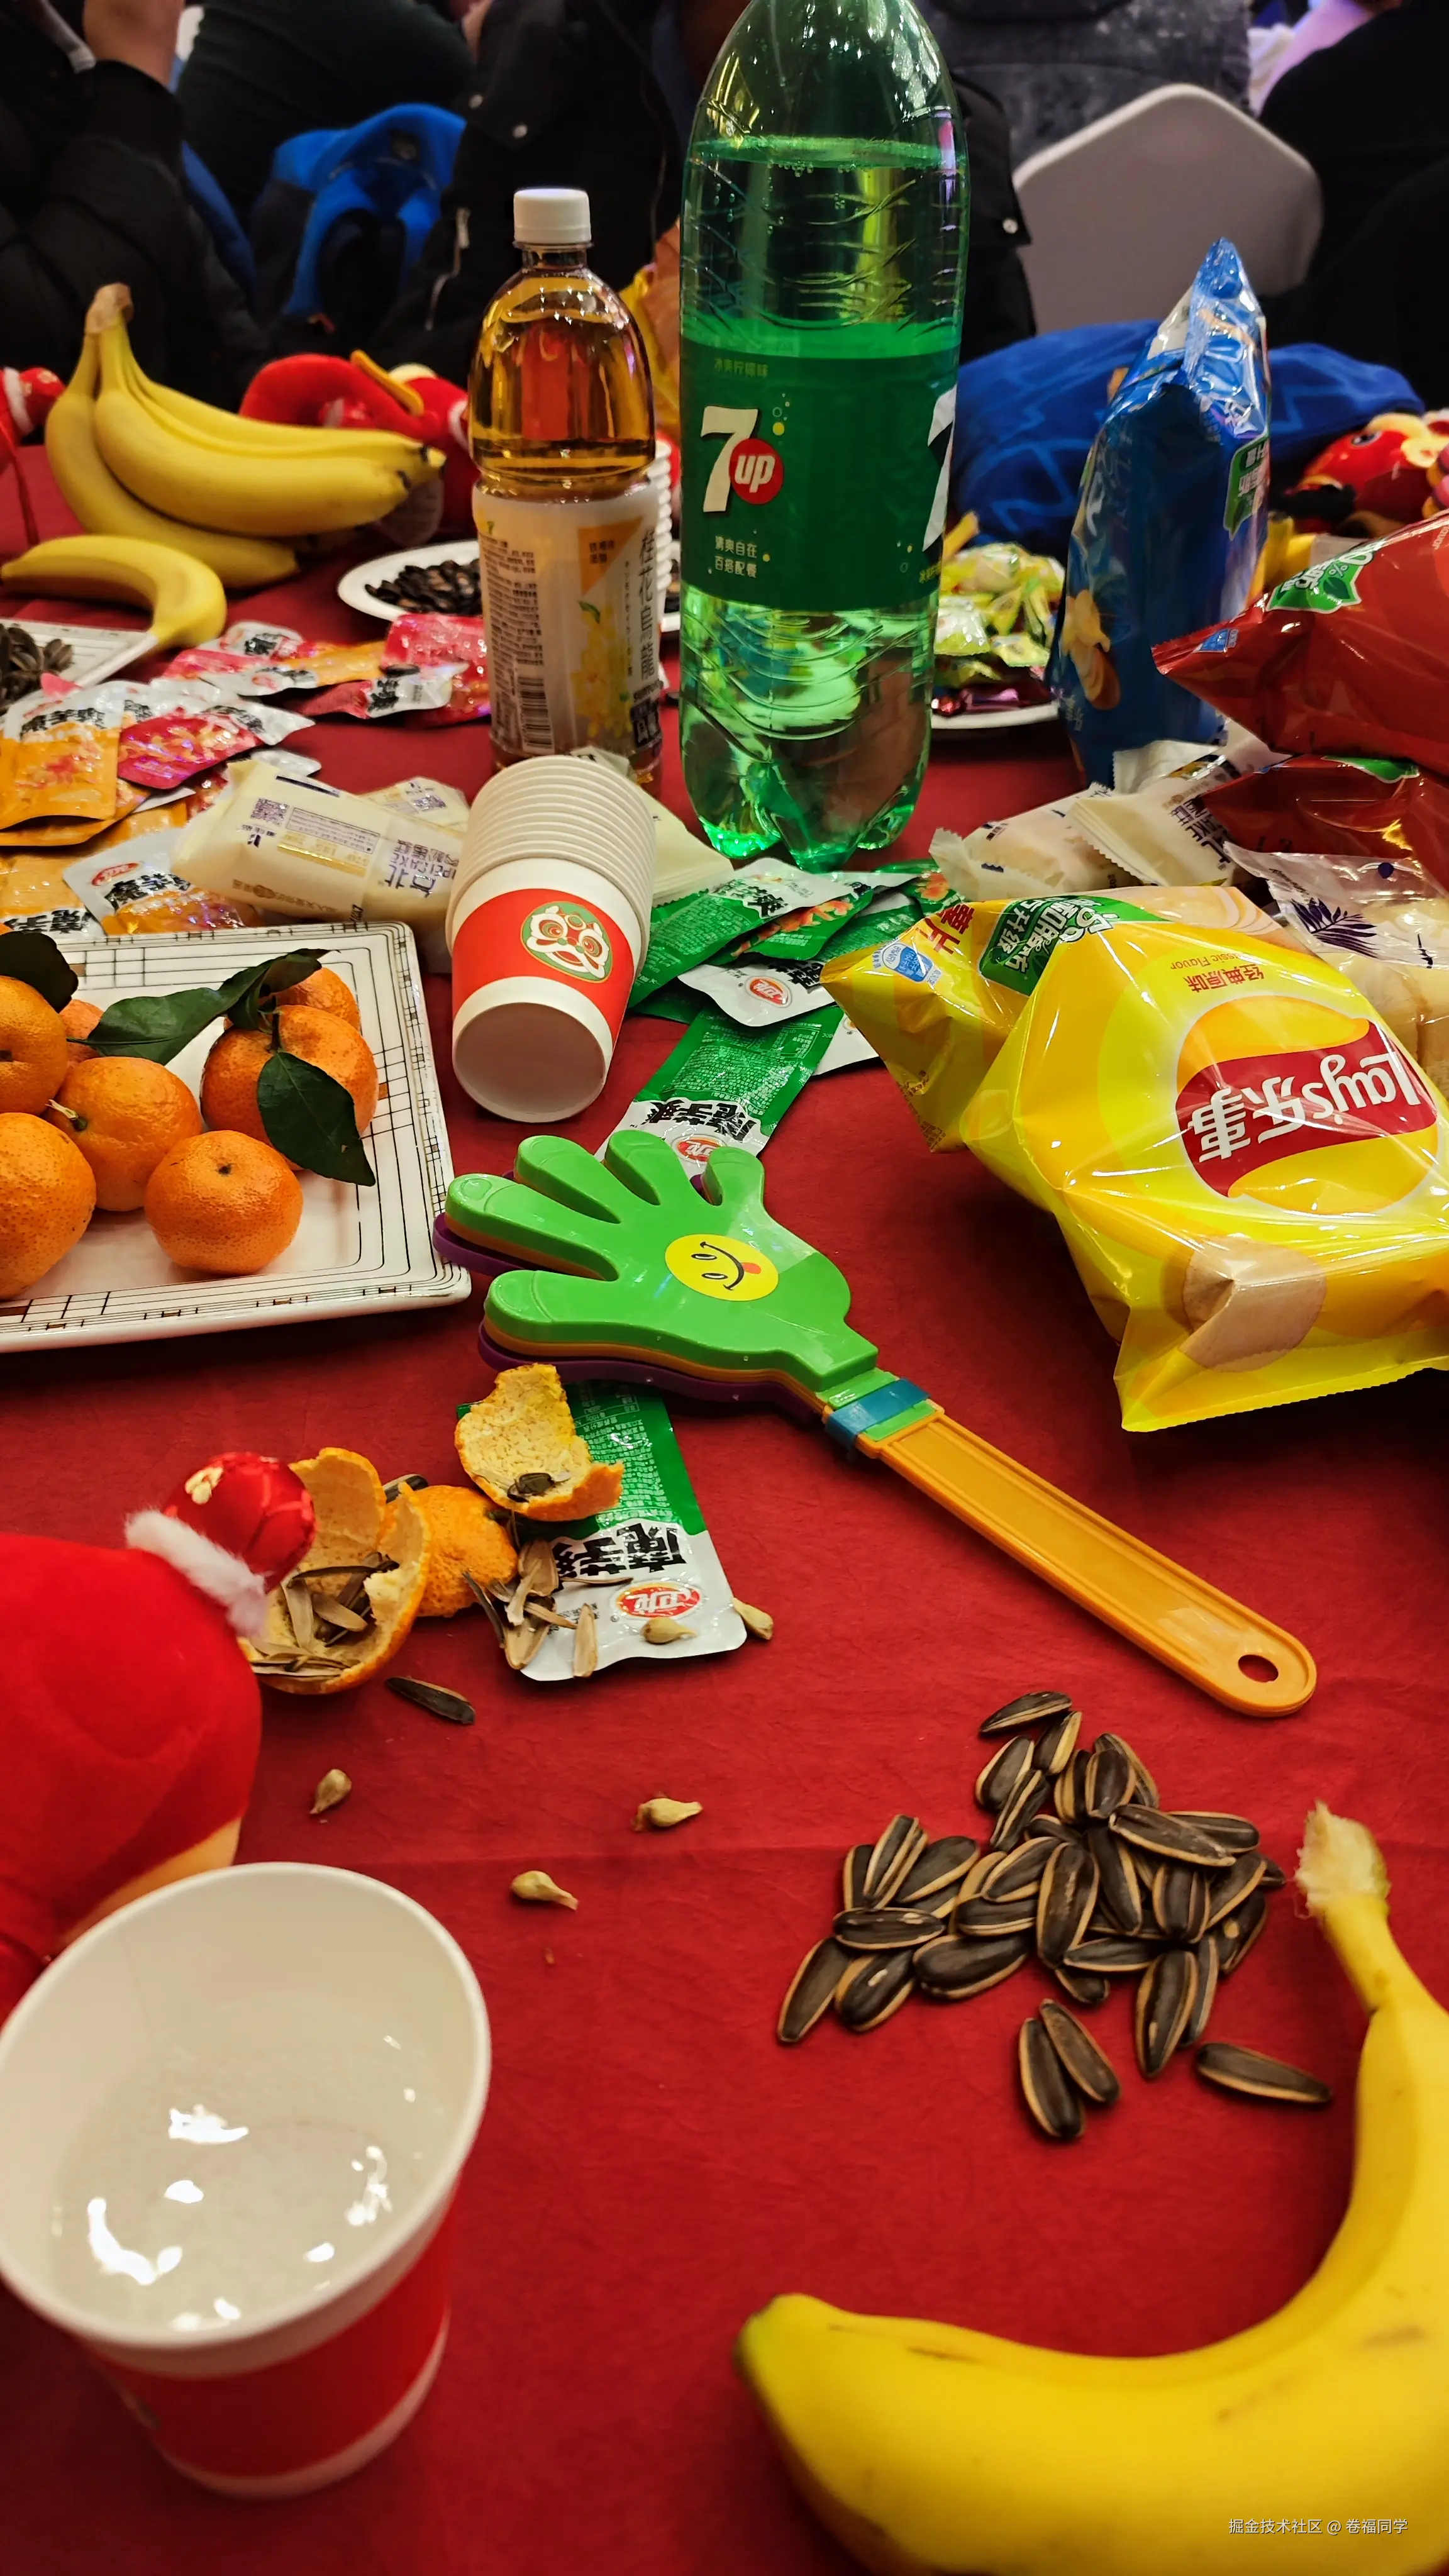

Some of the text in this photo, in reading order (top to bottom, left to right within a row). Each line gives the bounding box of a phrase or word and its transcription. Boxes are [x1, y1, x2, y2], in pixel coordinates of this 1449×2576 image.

[715, 536, 757, 558] 清爽自在
[1170, 955, 1212, 970] Flavor
[1183, 963, 1265, 993] 经典原味
[1190, 1076, 1307, 1163] 乐事
